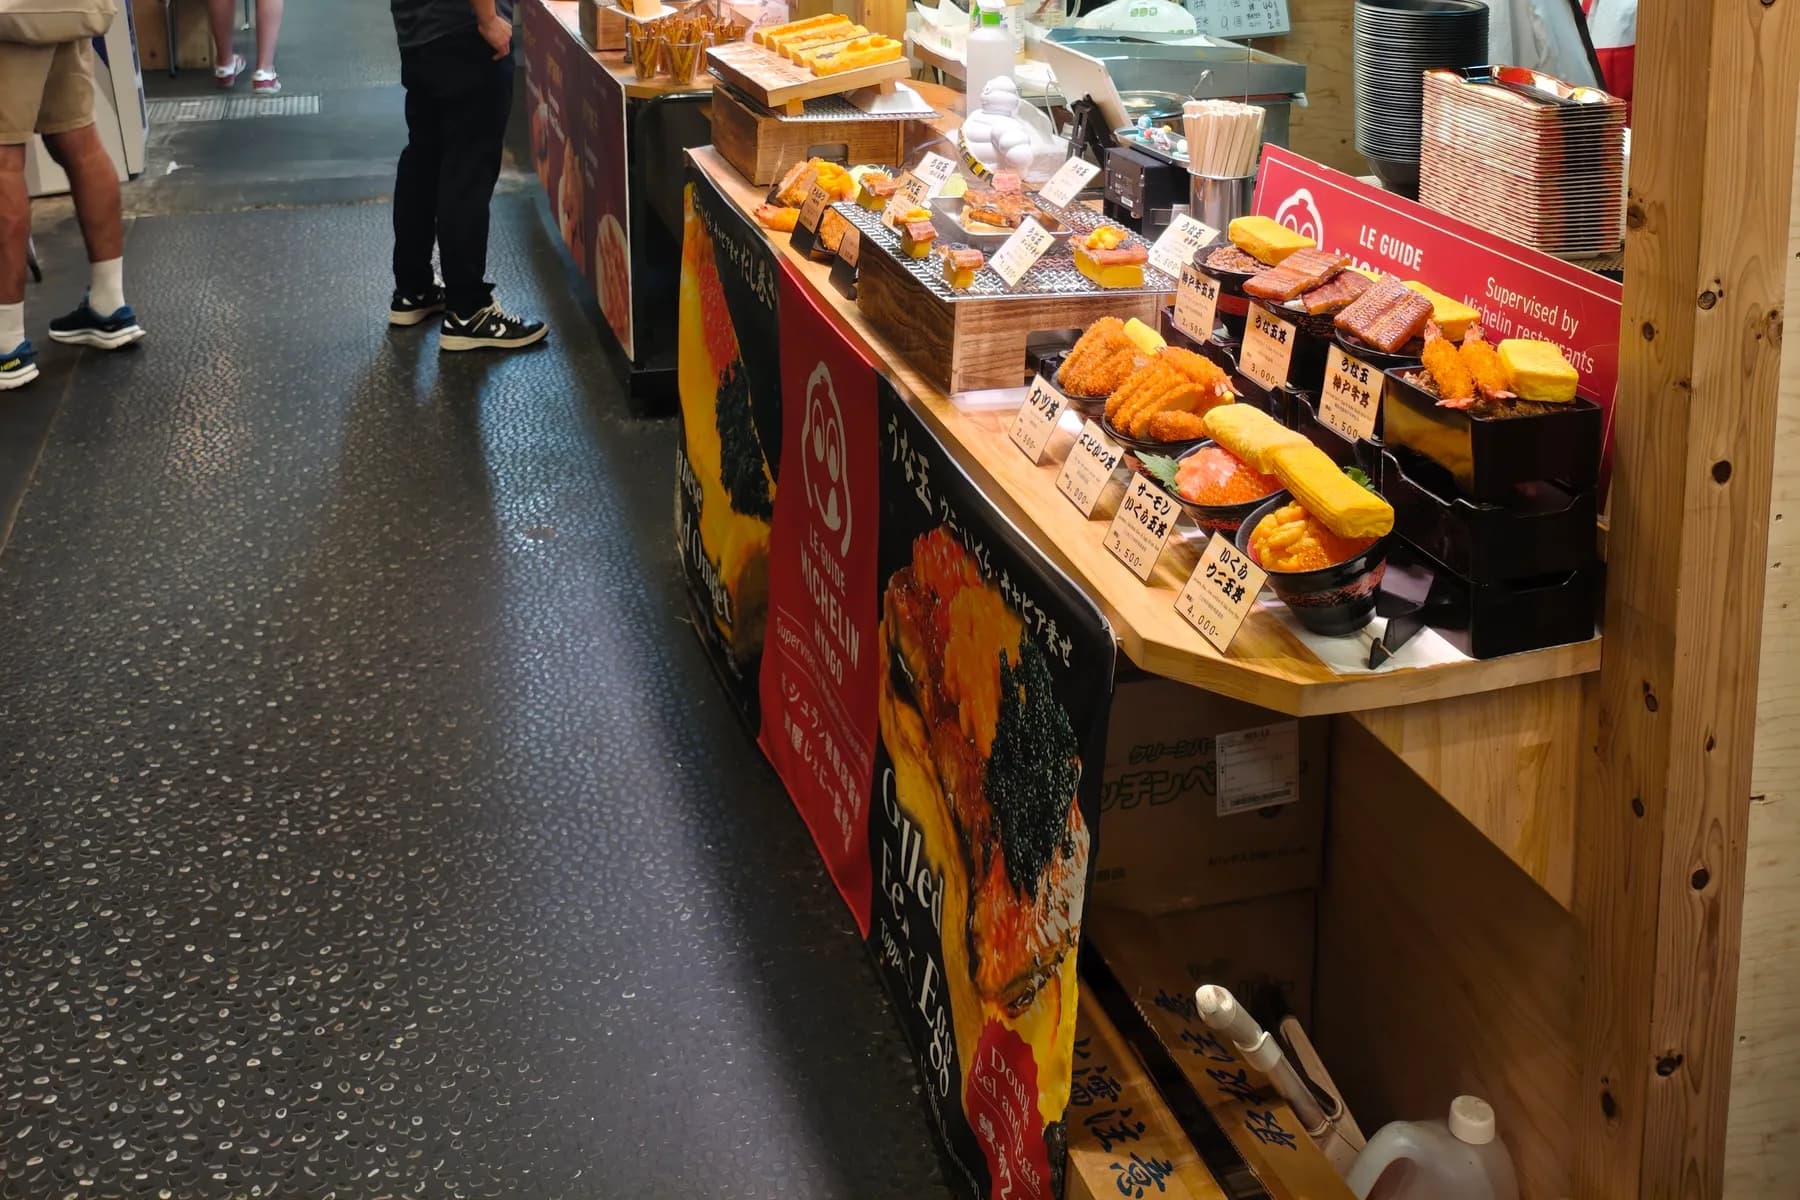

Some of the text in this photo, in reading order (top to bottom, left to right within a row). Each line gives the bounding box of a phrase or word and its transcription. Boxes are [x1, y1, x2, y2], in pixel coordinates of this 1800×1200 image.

[1360, 224, 1377, 250] LE
[1380, 233, 1424, 272] GUIDE
[1485, 276, 1579, 340] Supervised by
[1341, 356, 1370, 385] うな玉
[1515, 324, 1595, 374] restrants
[1030, 386, 1060, 421] カツ丼
[1124, 495, 1168, 539] いくら玉丼
[1137, 482, 1172, 516] サーモン
[808, 522, 846, 598] LE GUIDE
[1206, 562, 1246, 604] ウニ玉丼
[1219, 546, 1249, 580] いくら
[801, 539, 860, 672] MICHELIN
[814, 618, 844, 686] HYOGO
